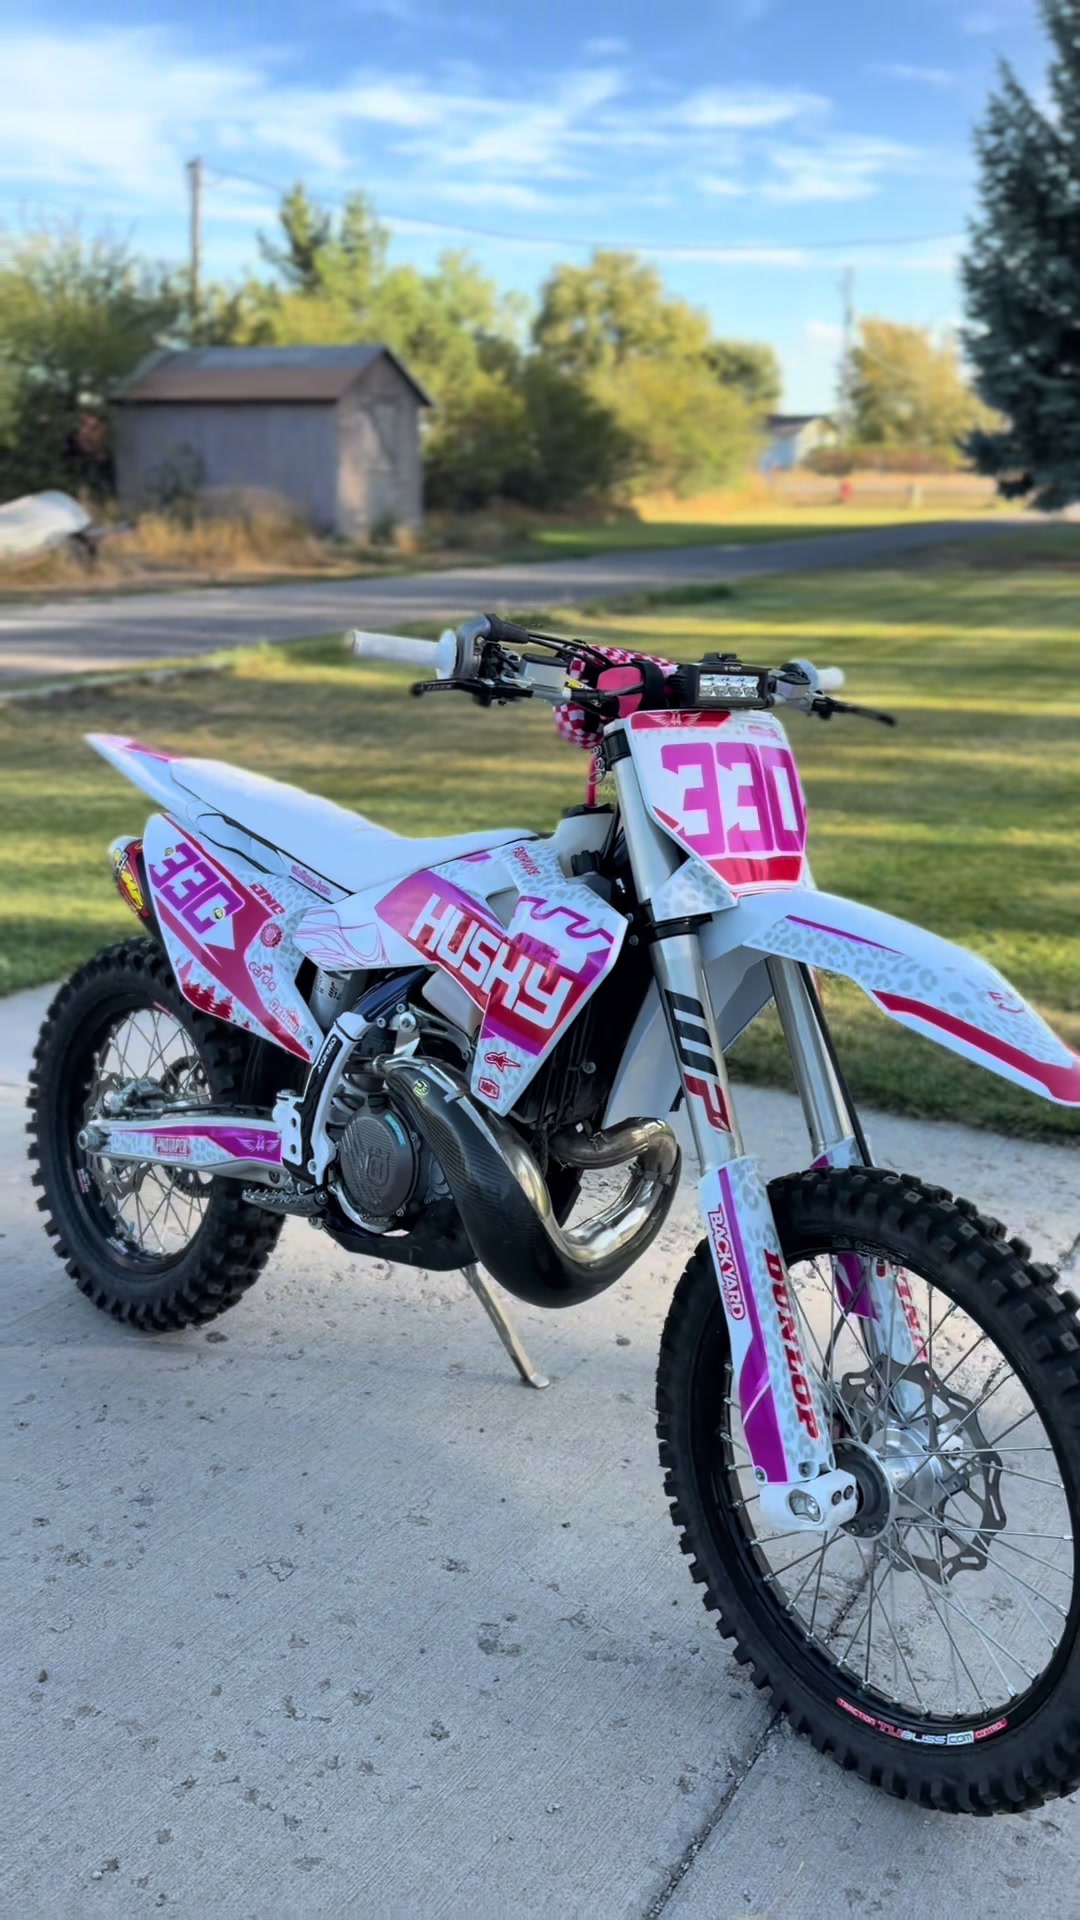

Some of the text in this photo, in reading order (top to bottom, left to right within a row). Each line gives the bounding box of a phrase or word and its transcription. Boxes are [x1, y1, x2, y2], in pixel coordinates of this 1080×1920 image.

[661, 741, 806, 857] 330
[148, 841, 246, 935] 330
[248, 961, 277, 992] cardo
[408, 892, 574, 1029] HUSKY
[708, 1203, 746, 1320] BACKYARD
[763, 1248, 820, 1440] DUNLOP
